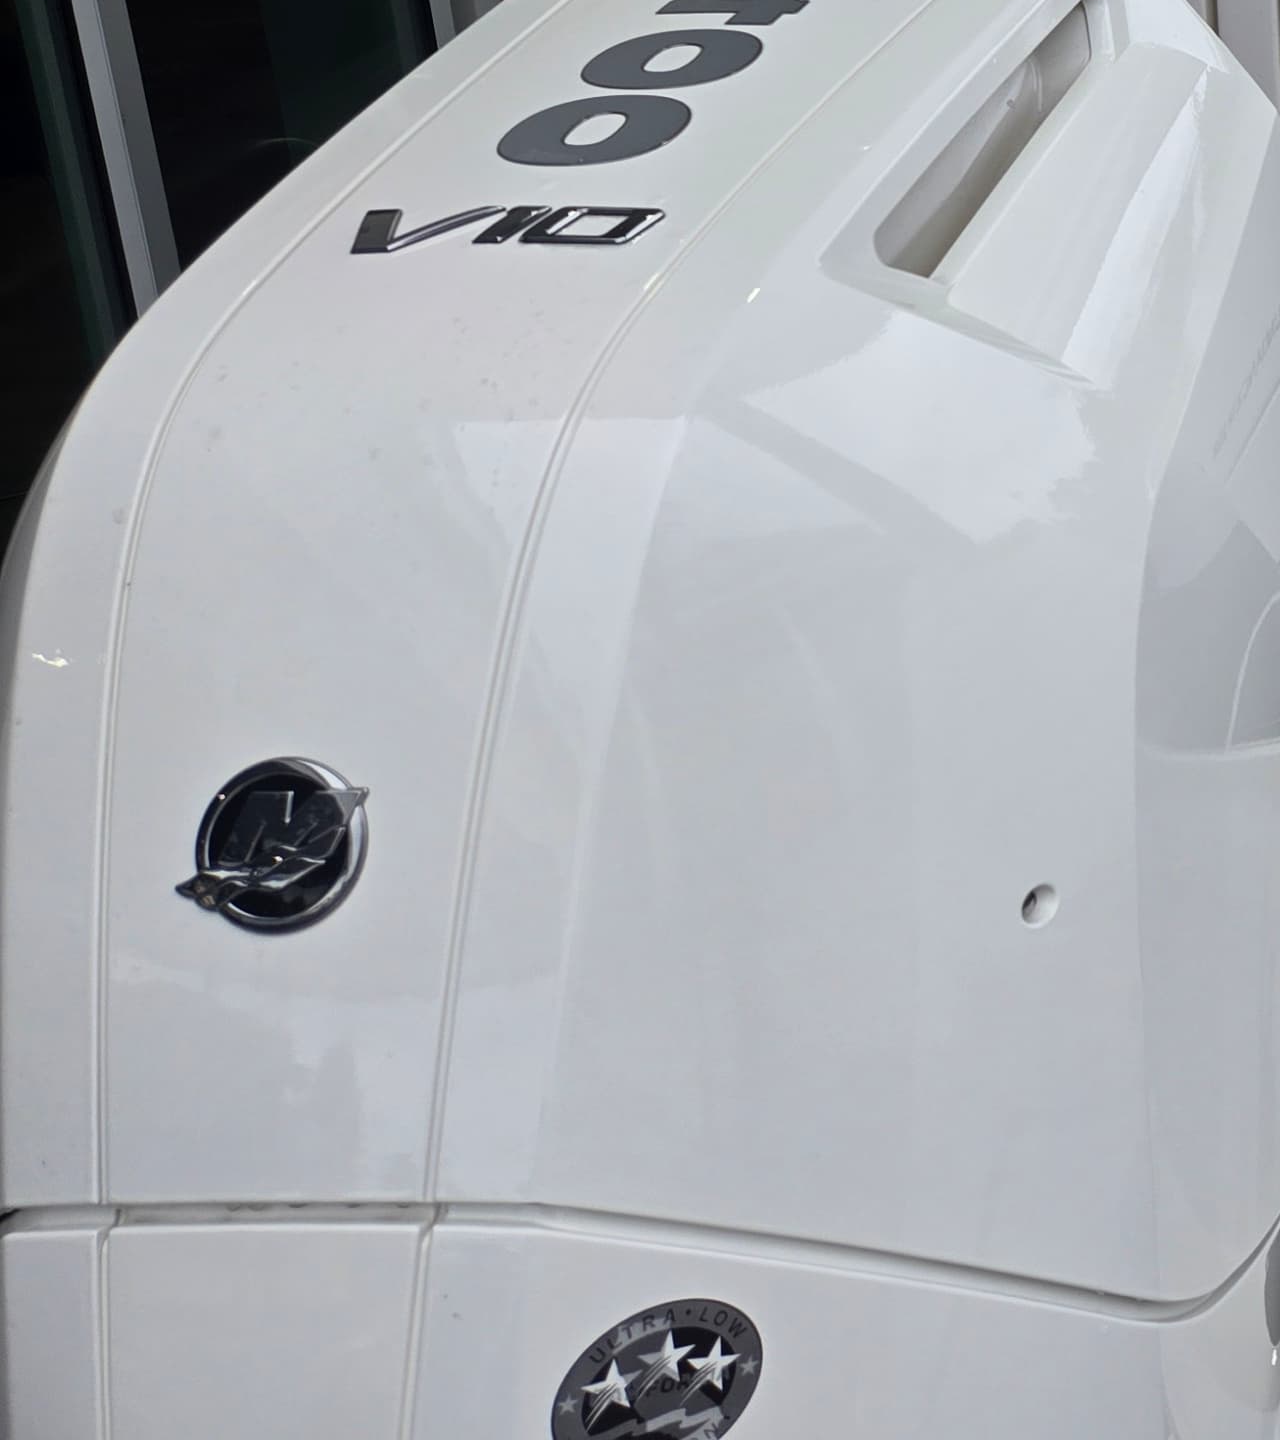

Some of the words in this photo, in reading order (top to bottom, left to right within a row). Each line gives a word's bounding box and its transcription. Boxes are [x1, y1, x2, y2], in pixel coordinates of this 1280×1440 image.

[349, 205, 666, 255] V10
[589, 1307, 677, 1365] ULTRA
[699, 1306, 747, 1339] LOW
